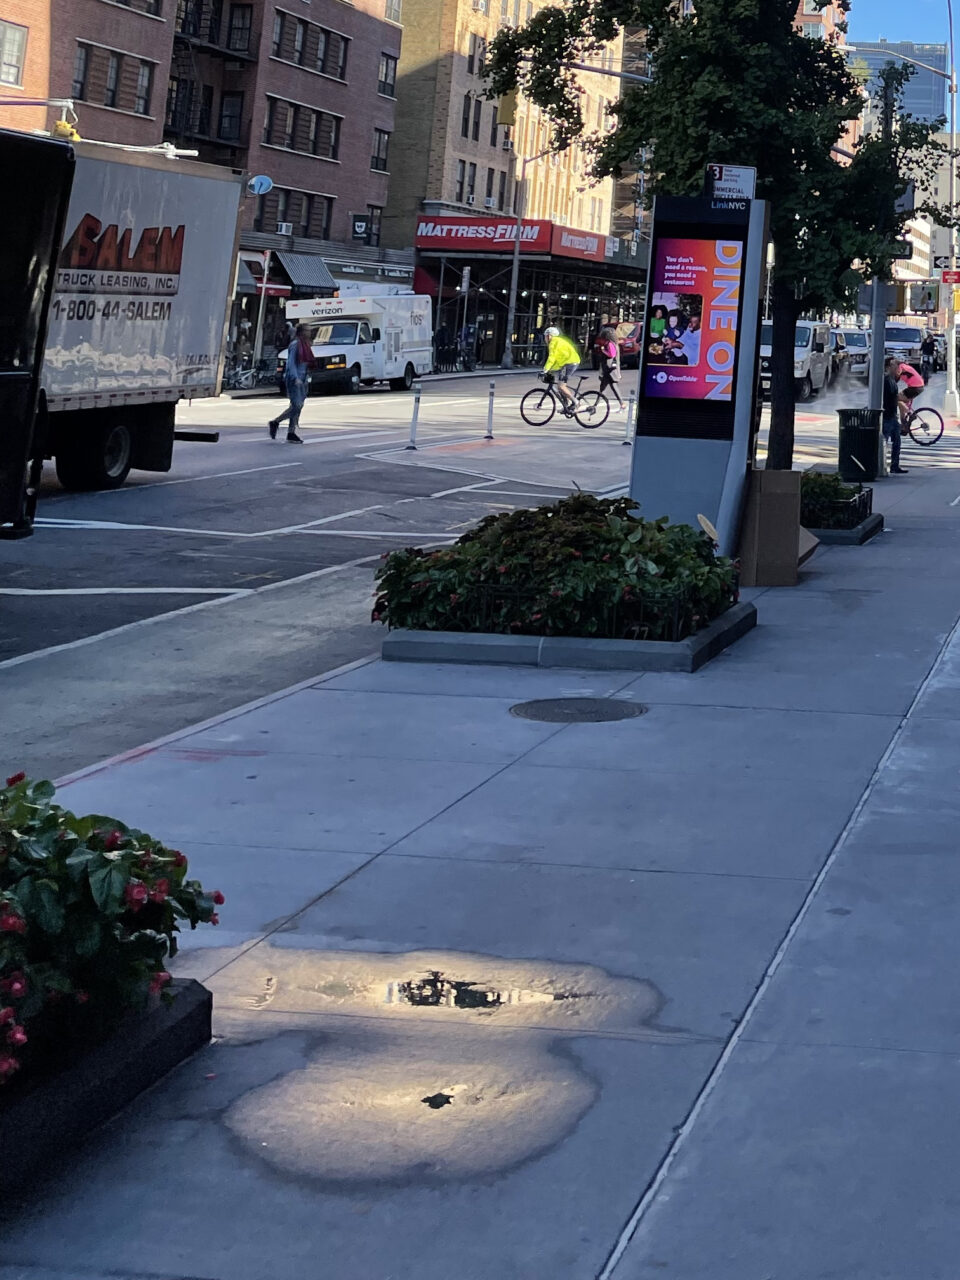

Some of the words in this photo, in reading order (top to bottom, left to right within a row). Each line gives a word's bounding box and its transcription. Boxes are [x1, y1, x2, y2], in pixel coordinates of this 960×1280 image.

[713, 166, 720, 180] 3
[711, 200, 746, 210] LinkNYC
[60, 213, 185, 274] SALEM
[665, 255, 677, 263] You
[57, 273, 96, 286] TRUCK
[100, 274, 150, 290] LEASING,
[155, 277, 176, 289] INC.
[709, 240, 743, 331] DINE
[52, 299, 172, 321] 1-800-44-SALEM
[311, 307, 343, 316] verizon
[410, 310, 423, 326] fios
[704, 341, 734, 401] ON
